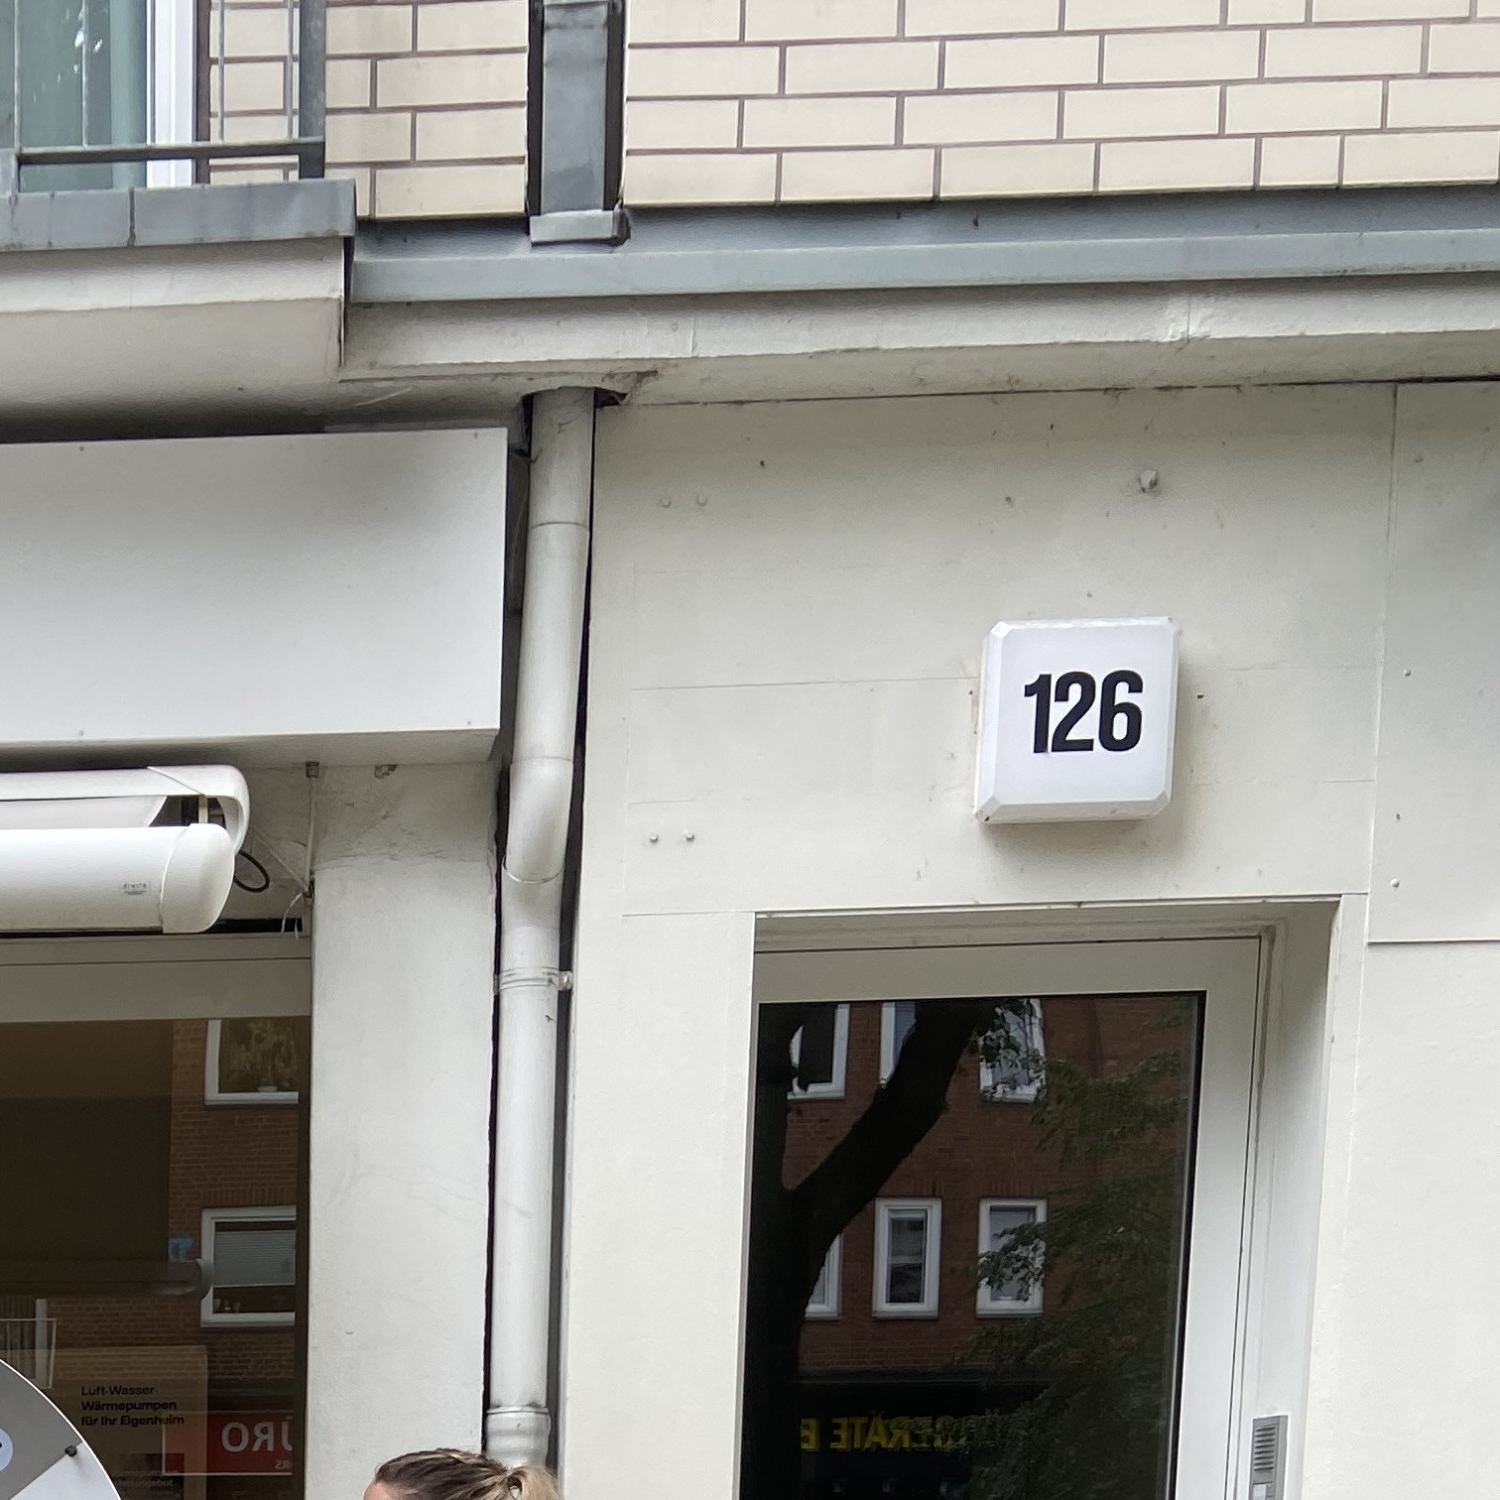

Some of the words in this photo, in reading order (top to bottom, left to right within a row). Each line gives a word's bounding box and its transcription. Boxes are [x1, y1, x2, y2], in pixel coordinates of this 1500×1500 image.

[1024, 669, 1143, 754] 126
[81, 1400, 178, 1413] Wärmepumpen
[81, 1415, 99, 1427] für
[101, 1415, 118, 1426] Ihr
[120, 1414, 185, 1428] Eigenheim
